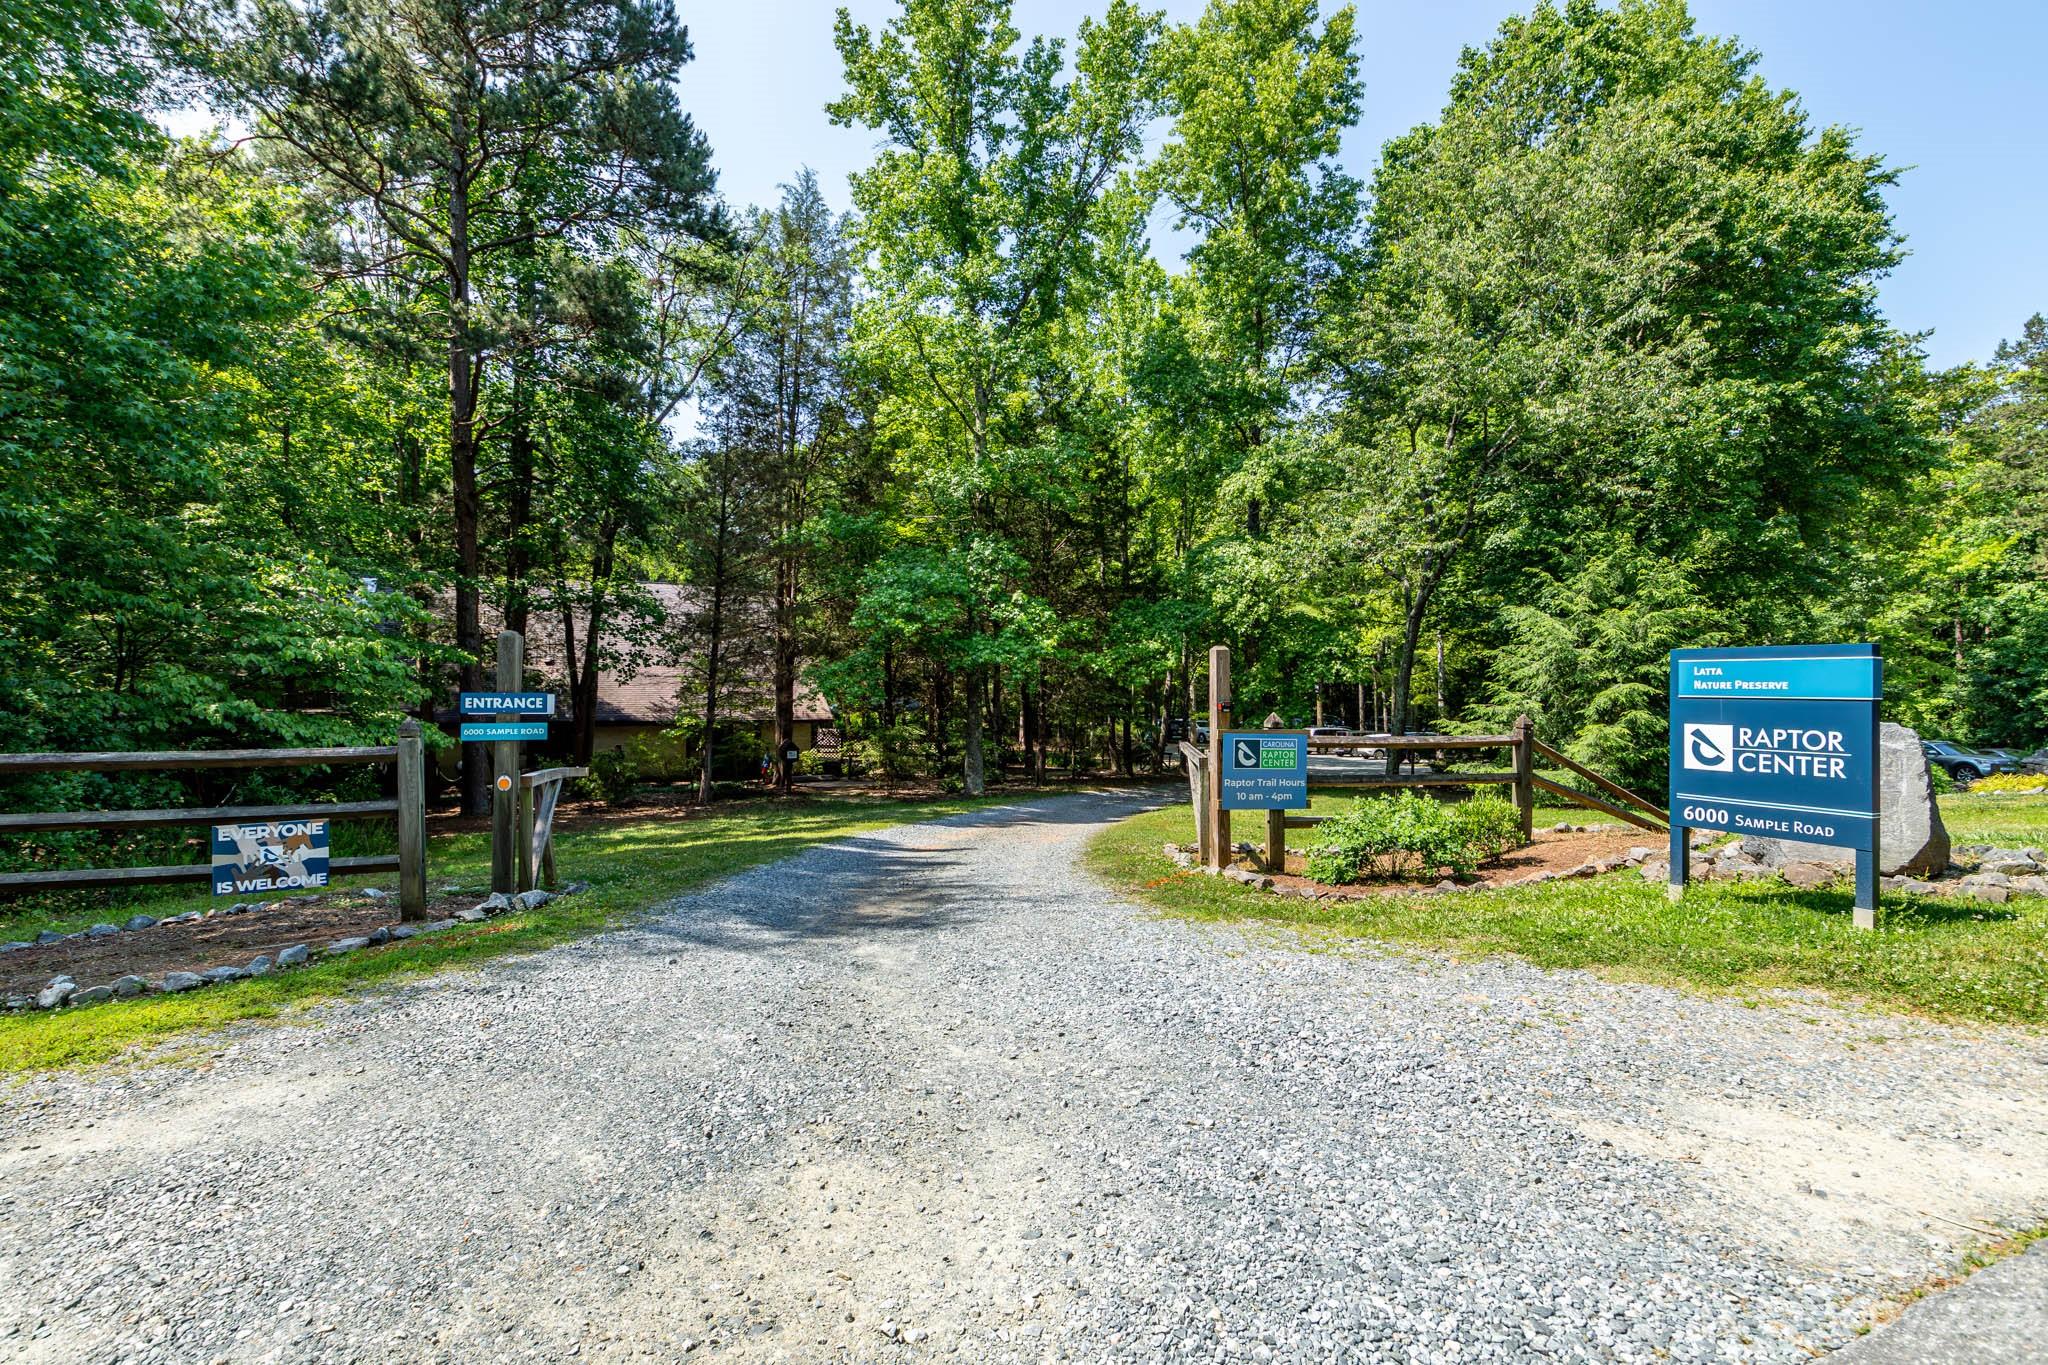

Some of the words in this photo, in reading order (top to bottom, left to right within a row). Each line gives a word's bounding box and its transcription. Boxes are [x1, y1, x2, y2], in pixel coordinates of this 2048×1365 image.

[464, 697, 544, 709] ENTRANCE
[463, 728, 485, 736] 6000
[520, 727, 545, 735] ROAD
[1738, 727, 1845, 752] RAPTOR
[1262, 751, 1295, 759] RAPTOR
[1738, 753, 1847, 779] CENTER
[1224, 778, 1255, 789] Raptor
[1257, 778, 1277, 786] Trail
[1279, 779, 1305, 787] Hours
[1237, 792, 1247, 800] 10
[1271, 792, 1293, 802] 4pm
[1683, 805, 1729, 825] 6000
[217, 822, 324, 842] EVERYONE
[216, 881, 234, 894] IS
[236, 872, 328, 892] WELCOME
